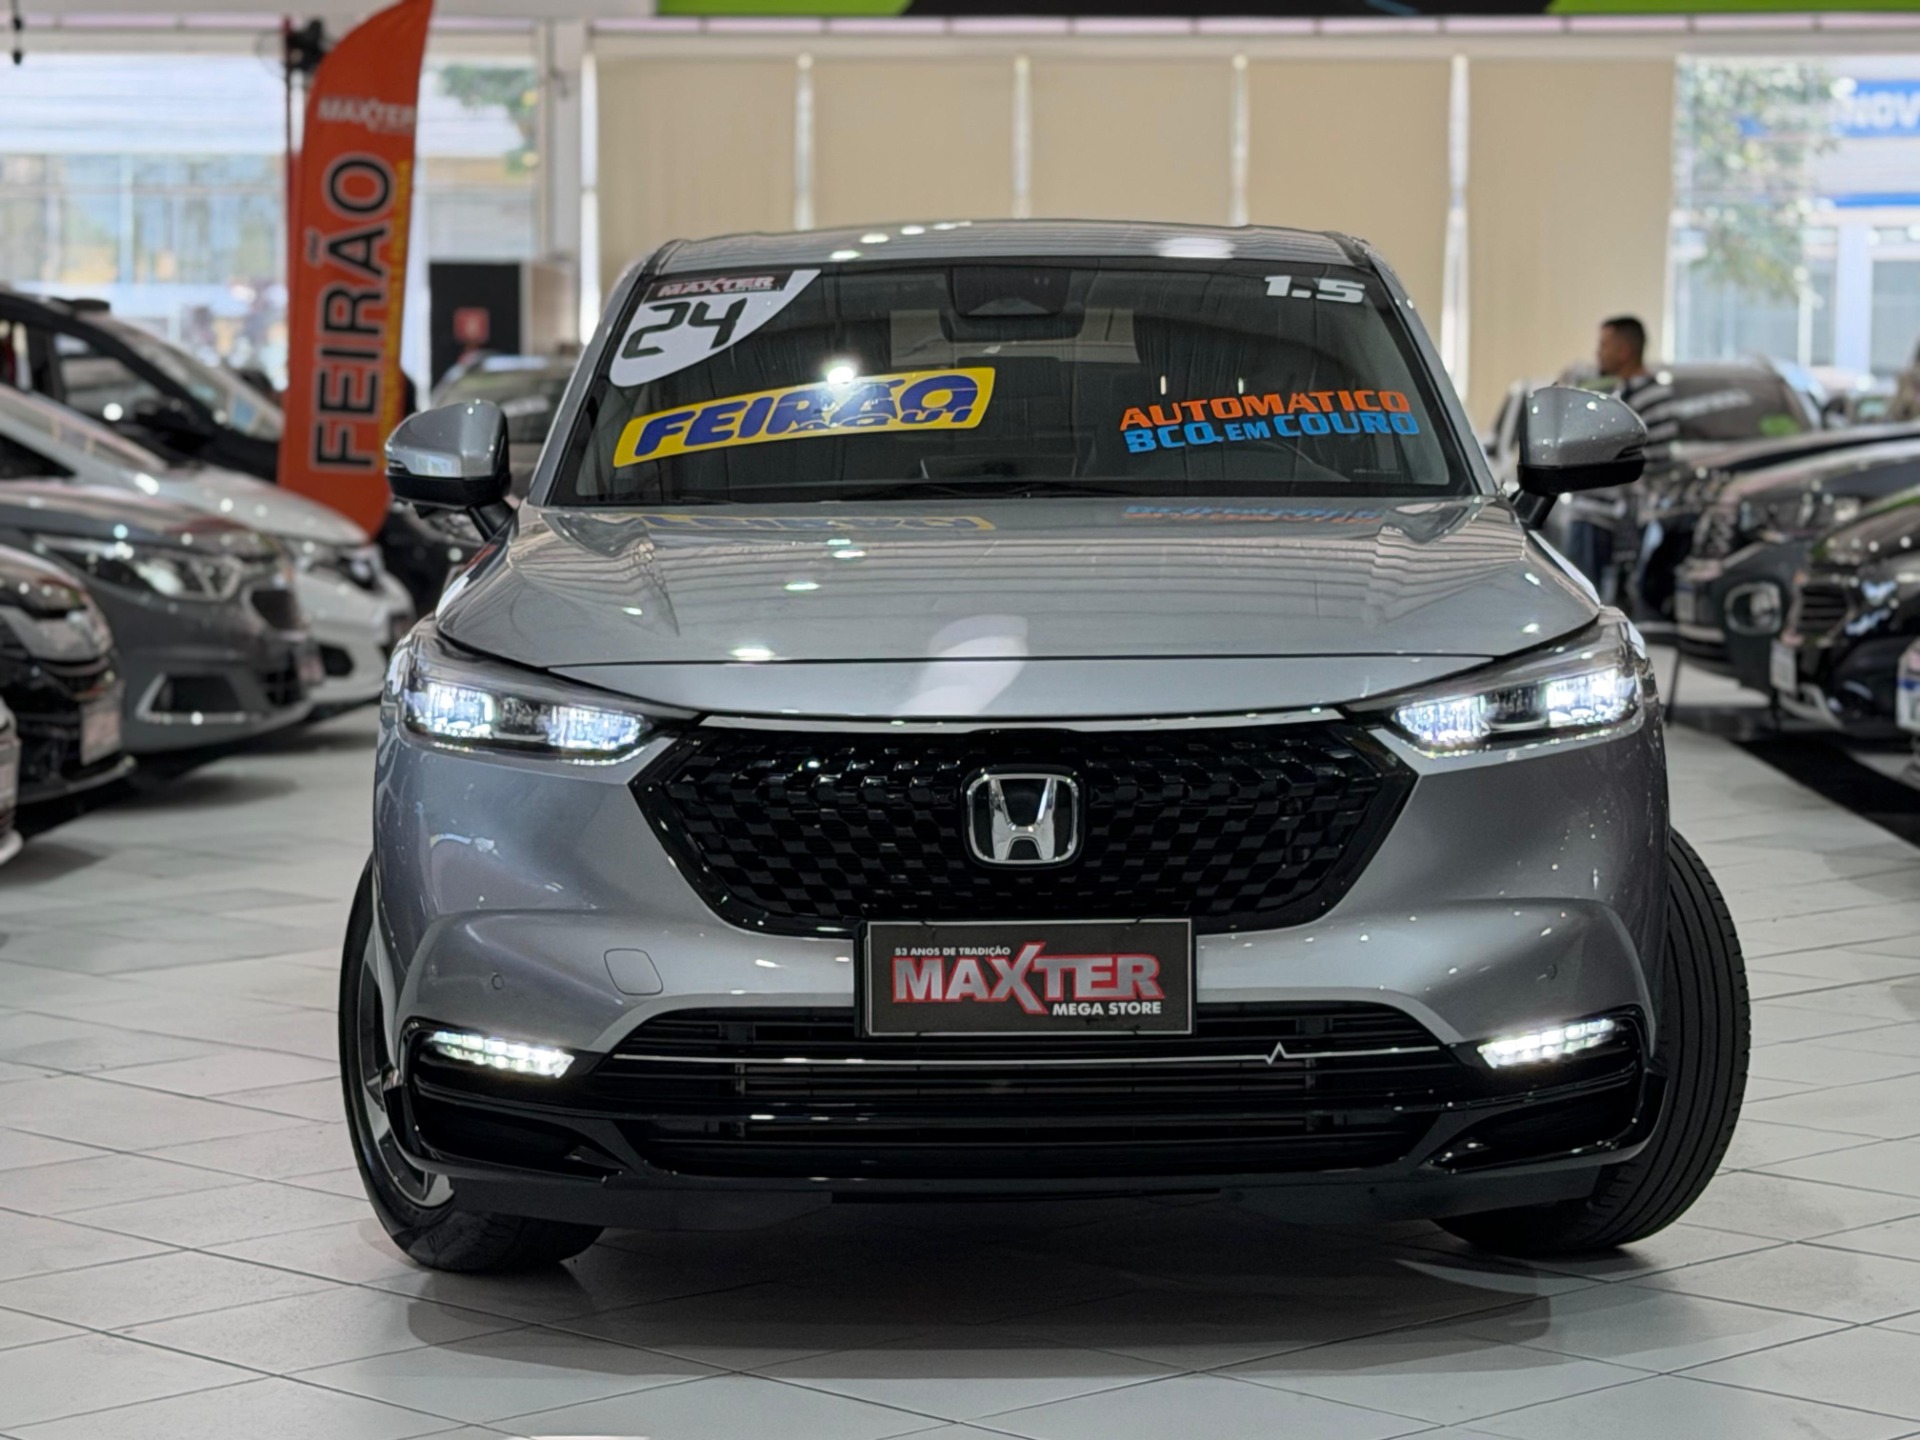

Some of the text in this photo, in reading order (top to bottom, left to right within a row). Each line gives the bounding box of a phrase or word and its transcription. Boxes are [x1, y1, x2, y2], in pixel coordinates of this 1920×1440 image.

[657, 275, 776, 297] MAXTER
[1264, 275, 1365, 304] 1.5
[307, 153, 396, 472] FEIRÃO
[621, 297, 748, 360] 24
[634, 375, 978, 457] FEIRÃO
[1225, 420, 1271, 442] EM
[1273, 411, 1421, 436] COURO
[910, 947, 940, 956] ANOS
[942, 947, 956, 956] DE
[958, 945, 1011, 957] TRADIÇÃO
[892, 941, 1166, 1014] MAXTER
[1052, 1002, 1162, 1016] MEGA STORE
